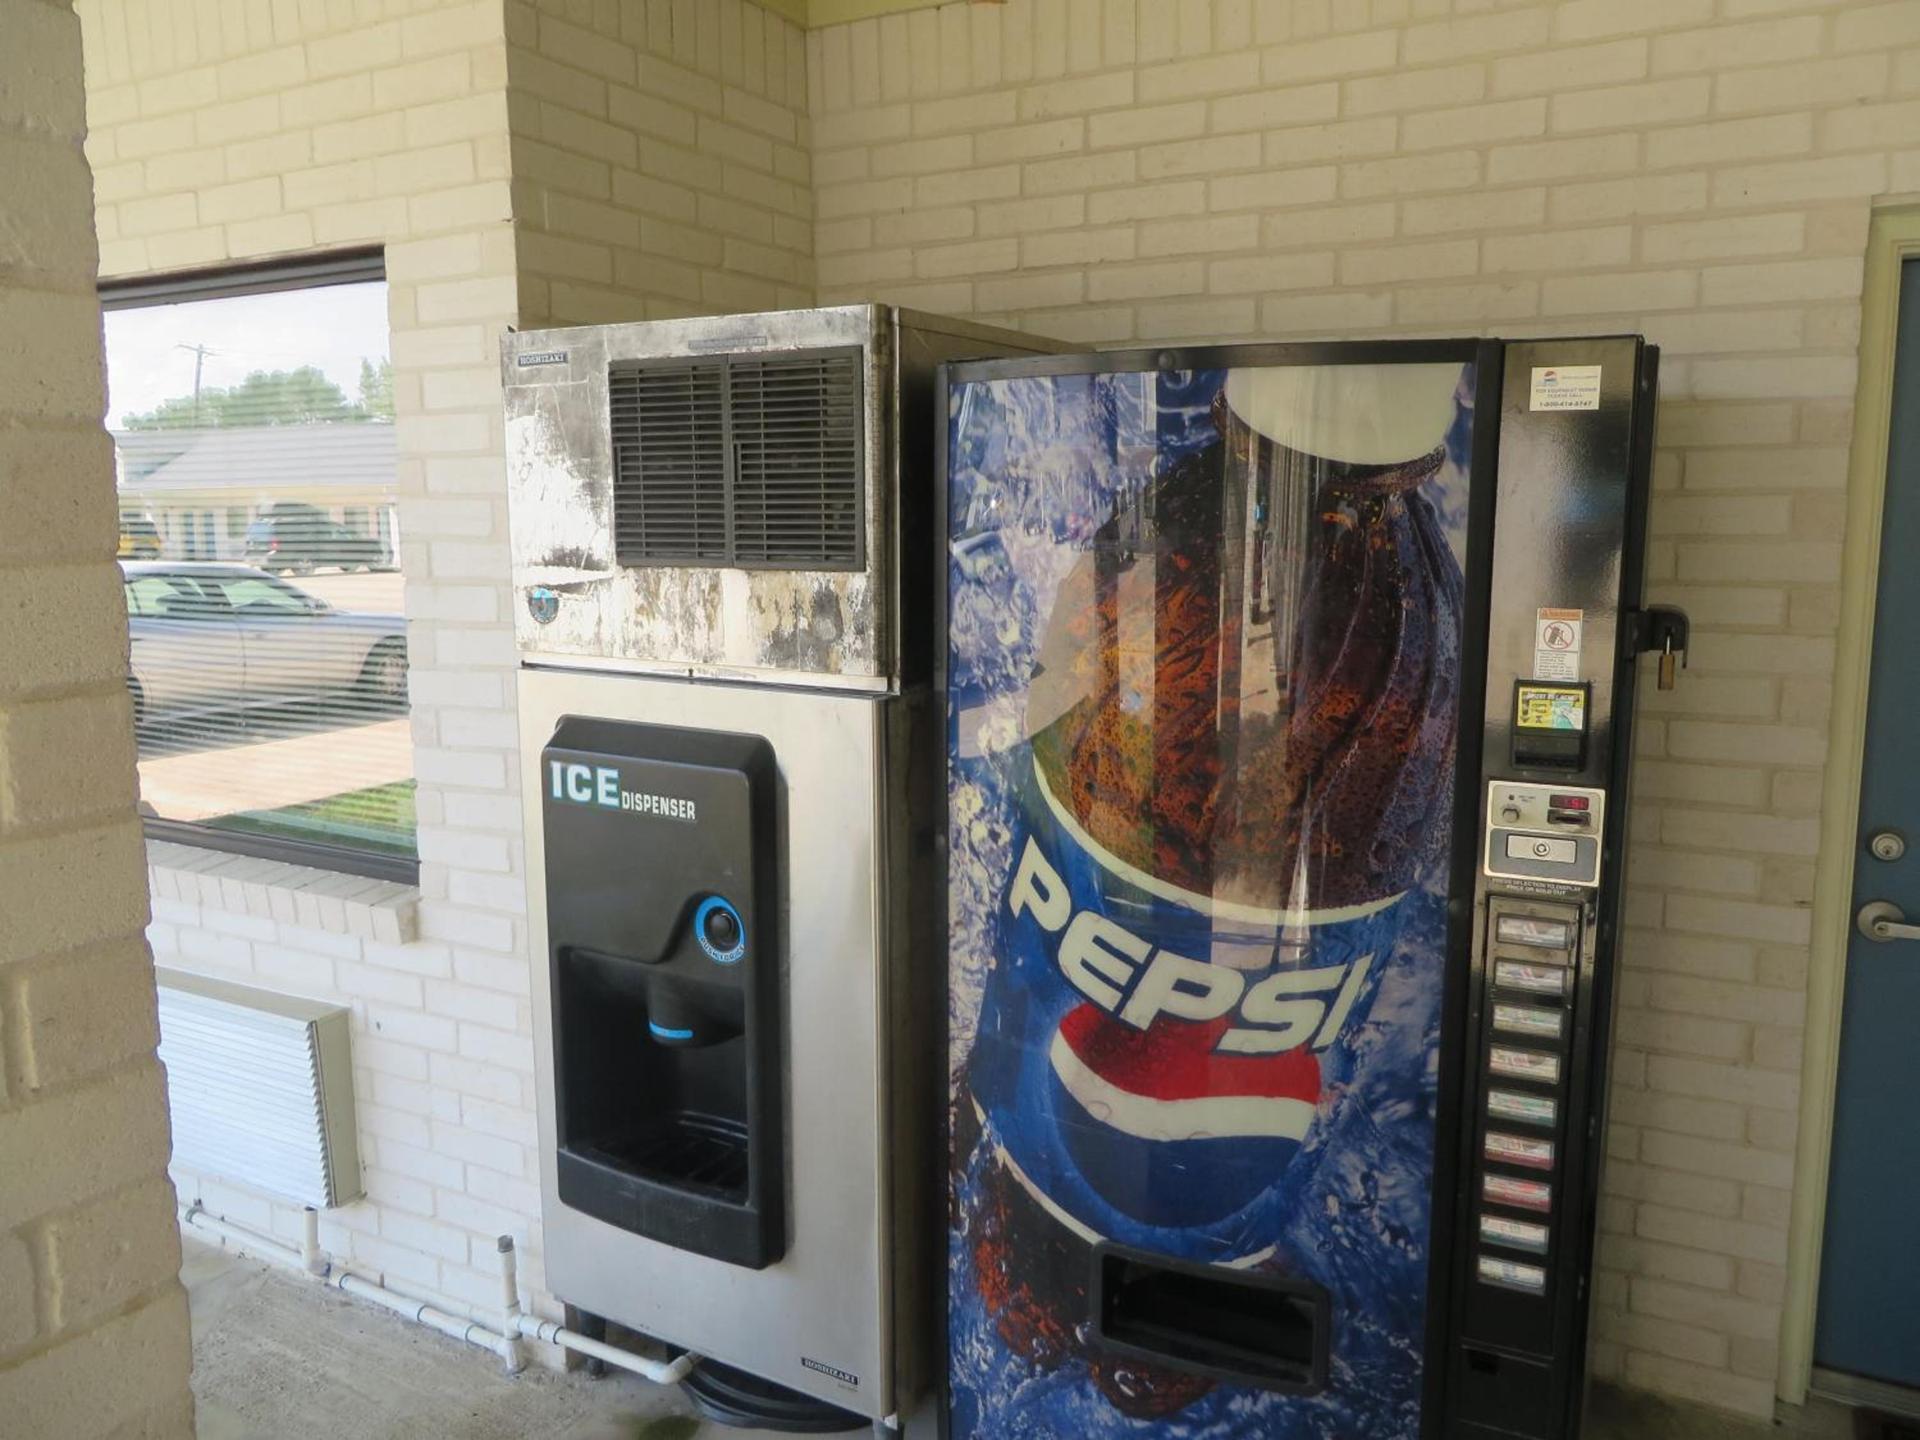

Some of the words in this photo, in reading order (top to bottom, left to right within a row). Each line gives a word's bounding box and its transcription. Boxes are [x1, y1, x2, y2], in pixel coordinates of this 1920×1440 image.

[550, 761, 620, 808] ICE
[622, 791, 696, 820] DISPENSER
[1009, 835, 1374, 1054] PEPSI
